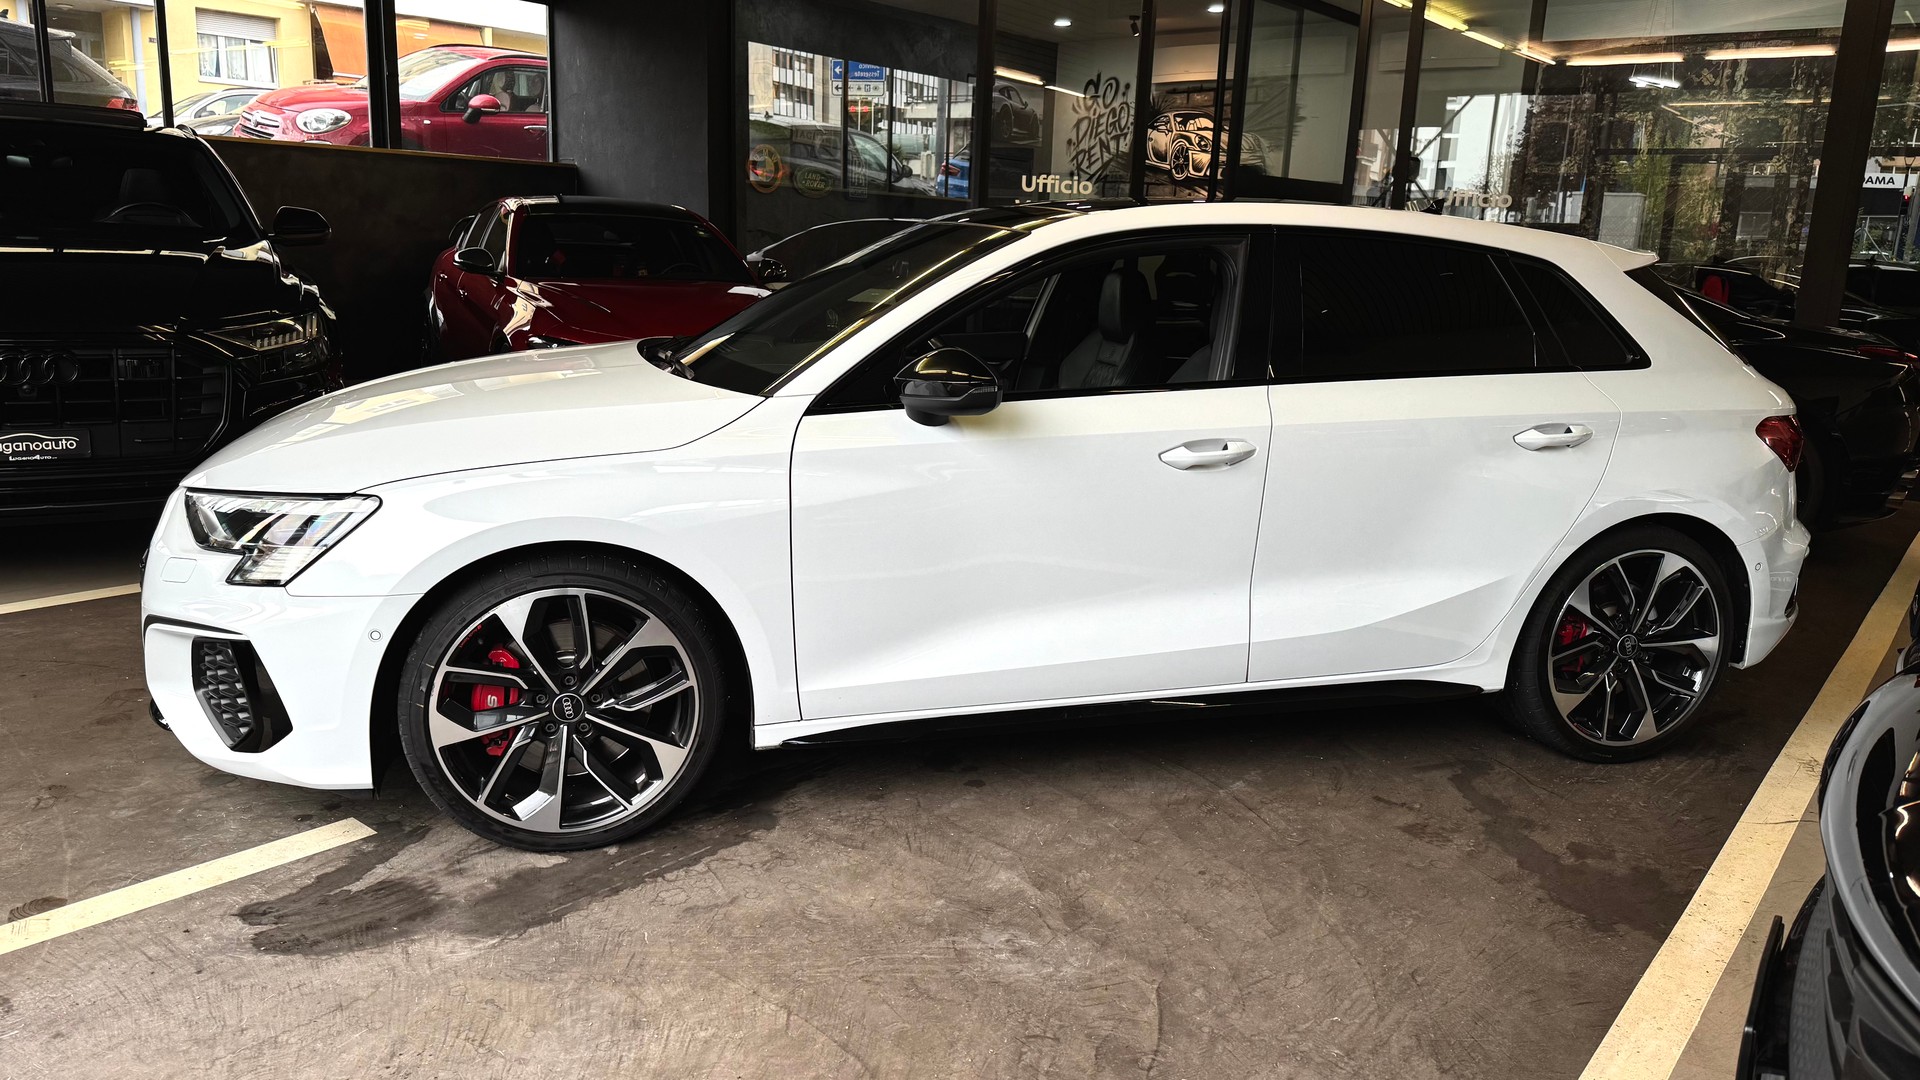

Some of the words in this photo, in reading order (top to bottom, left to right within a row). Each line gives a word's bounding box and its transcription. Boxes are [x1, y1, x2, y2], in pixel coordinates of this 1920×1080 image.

[1083, 71, 1120, 112] GO
[1071, 102, 1130, 151] DIEGO
[1068, 132, 1129, 175] RENT
[804, 171, 821, 181] LAND
[1021, 174, 1093, 194] Ufficio
[1864, 175, 1895, 185] AMA
[0, 439, 77, 454] ganoauto
